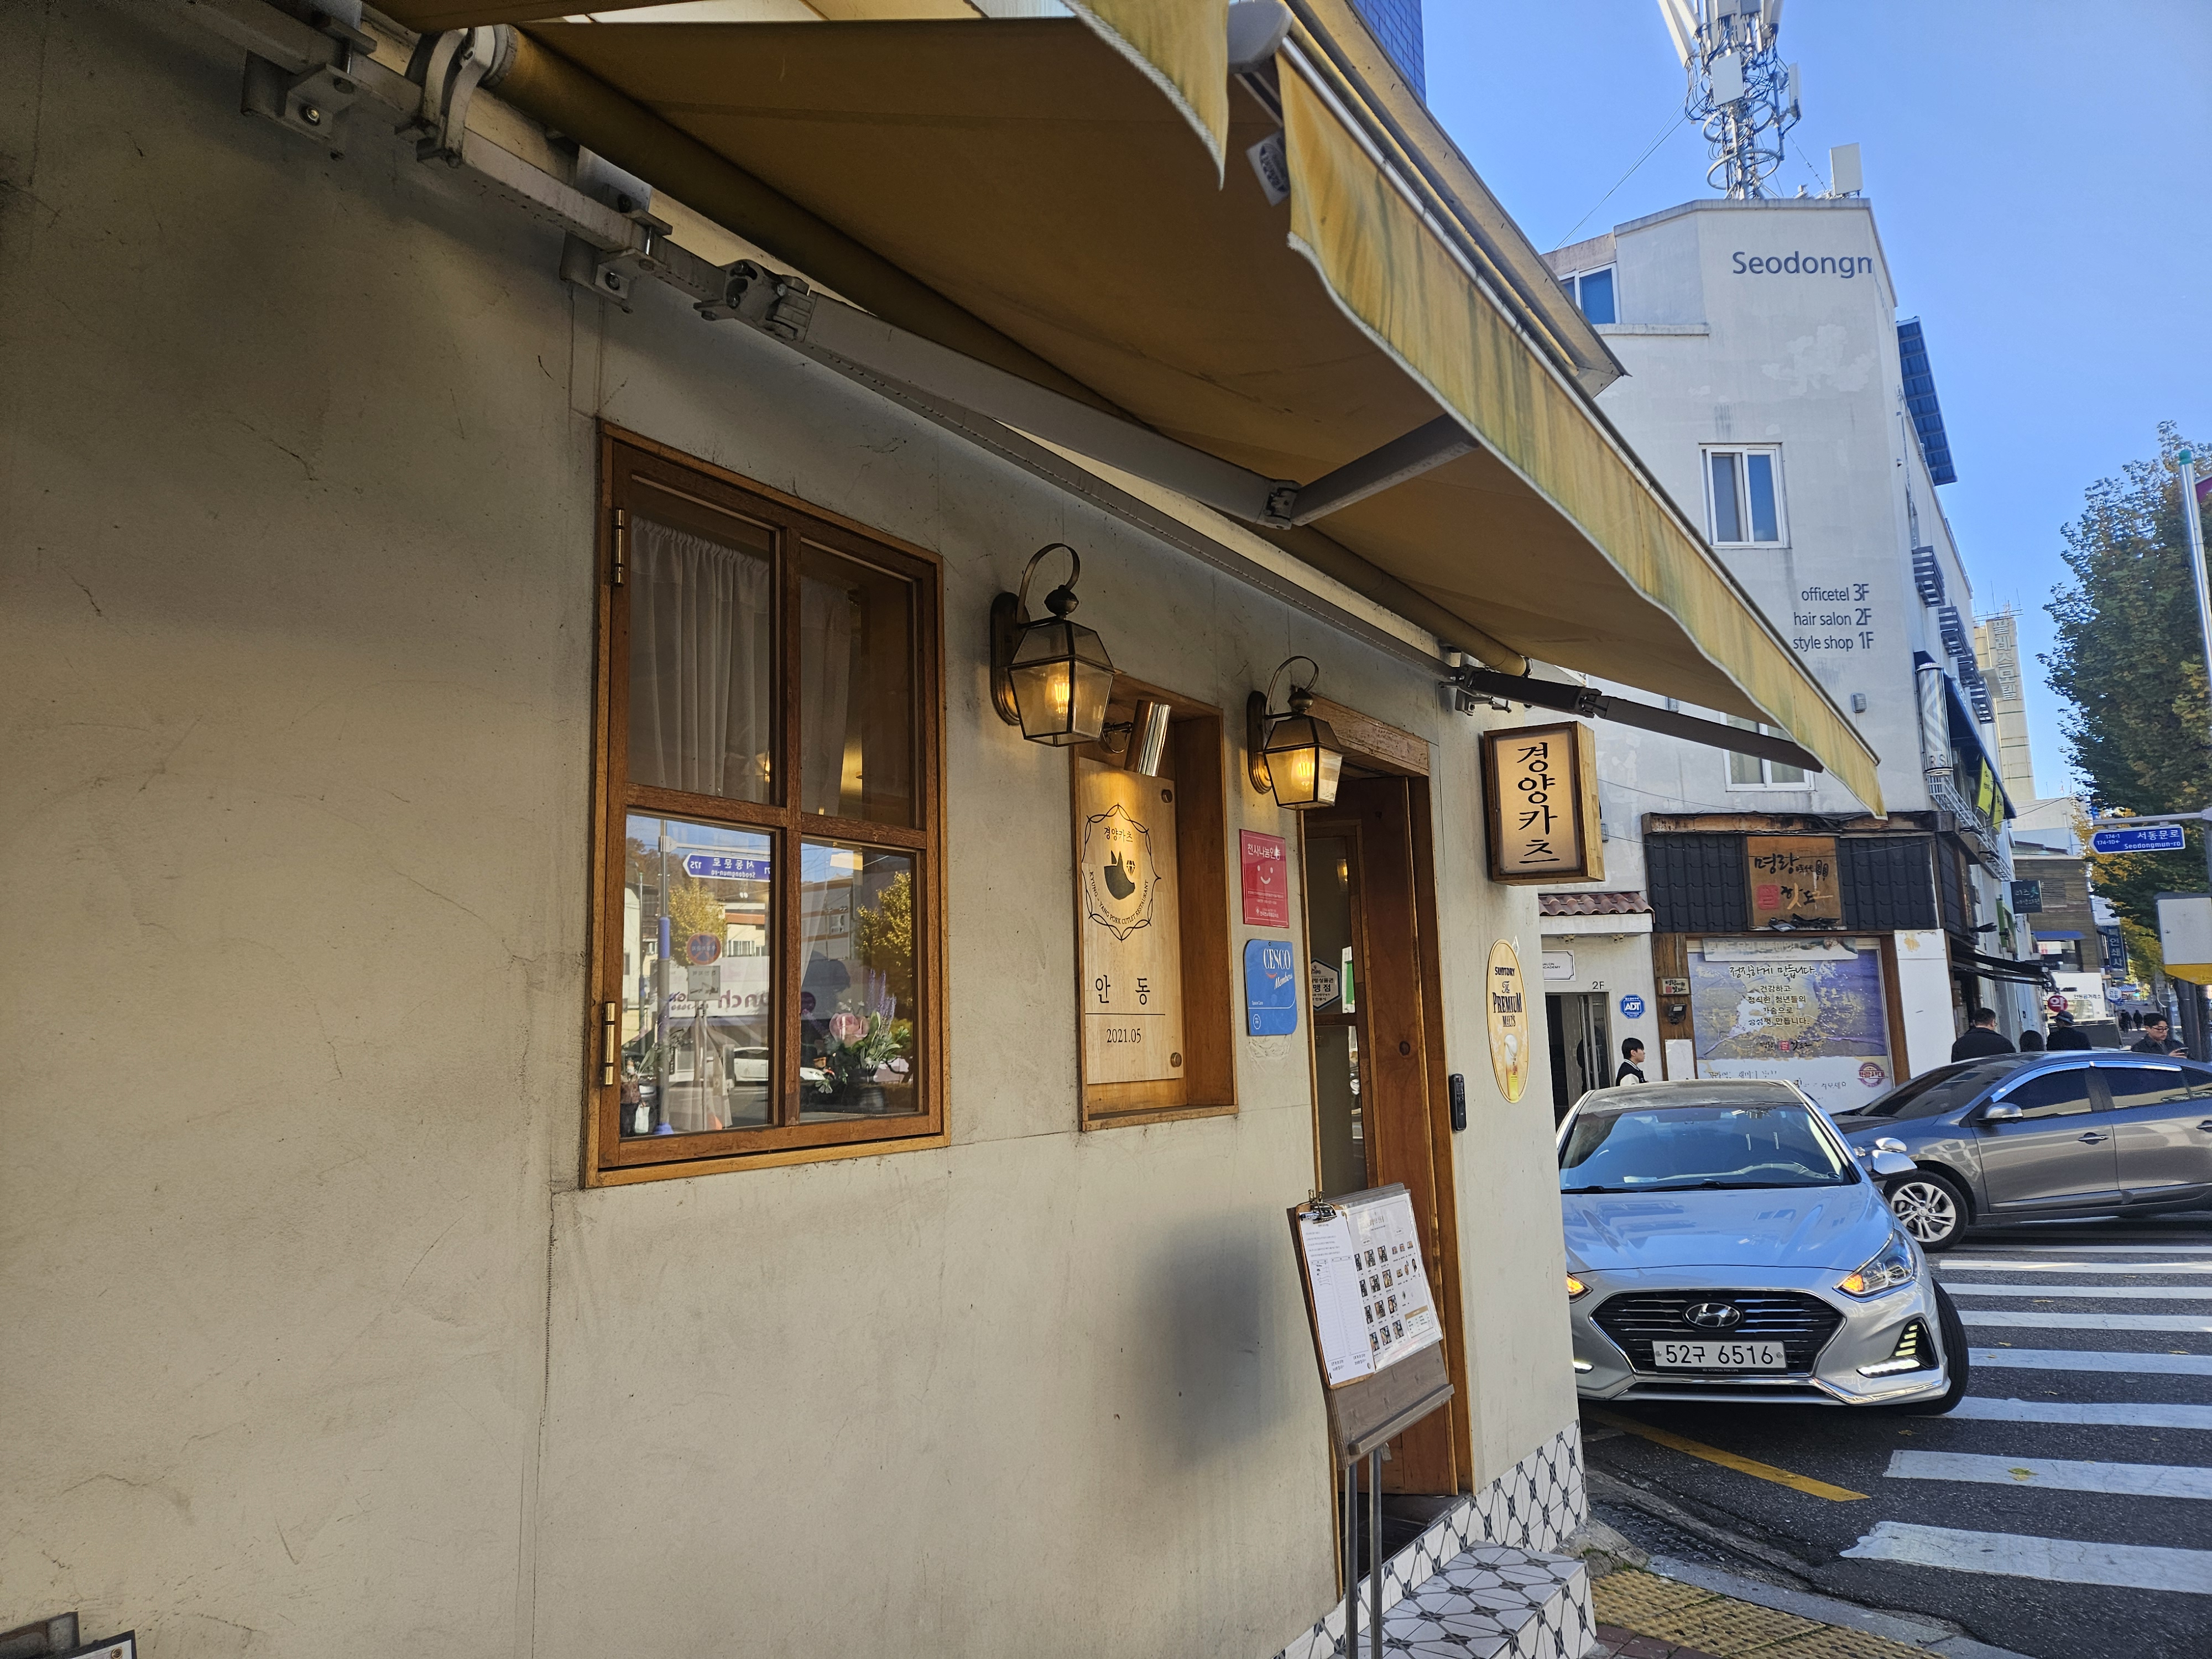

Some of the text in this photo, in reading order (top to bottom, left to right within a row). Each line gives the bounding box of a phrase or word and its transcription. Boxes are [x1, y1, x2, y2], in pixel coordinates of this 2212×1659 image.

[1802, 583, 1870, 601] officetel 3F
[1794, 608, 1872, 625] hair salon 2F
[1793, 632, 1874, 652] style shop 1F
[1517, 742, 1560, 863] 경양카츠
[2137, 830, 2180, 841] 서동문로
[2124, 841, 2181, 849] Seodongmun-ro
[1755, 852, 1799, 874] 명랑
[1089, 871, 1098, 897] KYUNG
[1099, 901, 1109, 917] YANG
[1109, 914, 1121, 925] PORK
[1121, 914, 1136, 925] CUTLET
[1135, 879, 1149, 917] RESTAURANT
[1263, 948, 1291, 969] CESCO
[1495, 967, 1515, 976] SUNTORY
[1729, 964, 1818, 979] 정직하게 만듭니다.
[1274, 972, 1292, 990] Members
[1593, 981, 1604, 989] 2F
[1492, 992, 1522, 1013] PREMIUM
[1624, 1002, 1641, 1011] ADT
[2050, 997, 2065, 1010] 약
[1107, 1029, 1141, 1043] 2021.05
[1666, 1345, 1773, 1364] 52구 6516
